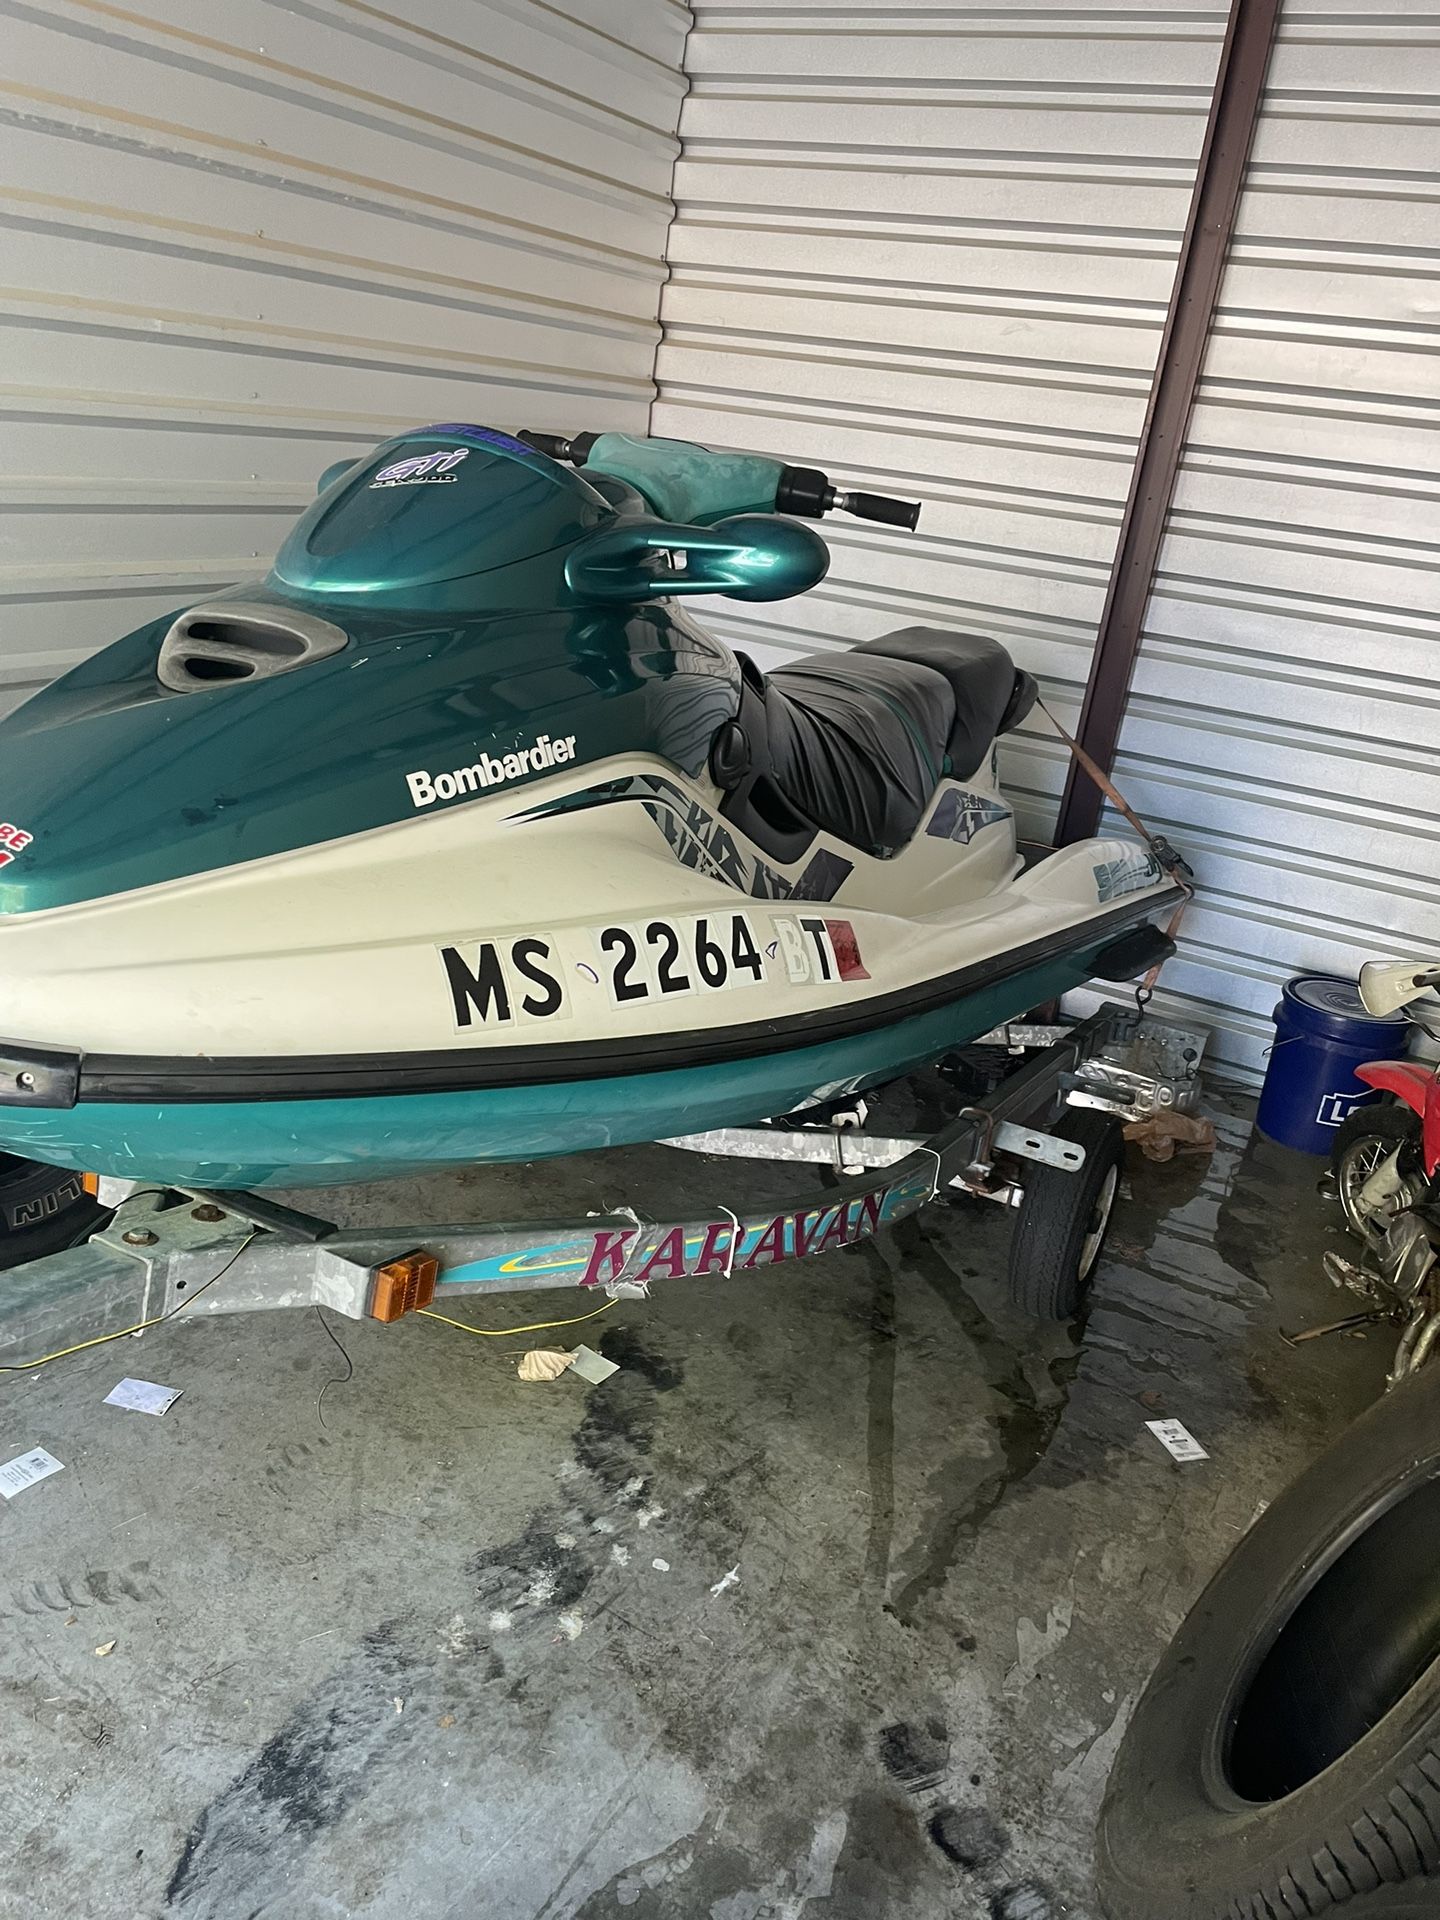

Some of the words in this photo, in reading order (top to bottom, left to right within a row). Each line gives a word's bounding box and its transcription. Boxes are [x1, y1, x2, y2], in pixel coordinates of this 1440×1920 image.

[405, 735, 578, 808] Bombardier
[441, 937, 564, 1027] MS
[600, 915, 763, 1003] 2264
[774, 918, 832, 983] BT
[579, 1188, 888, 1287] KARAVAN
